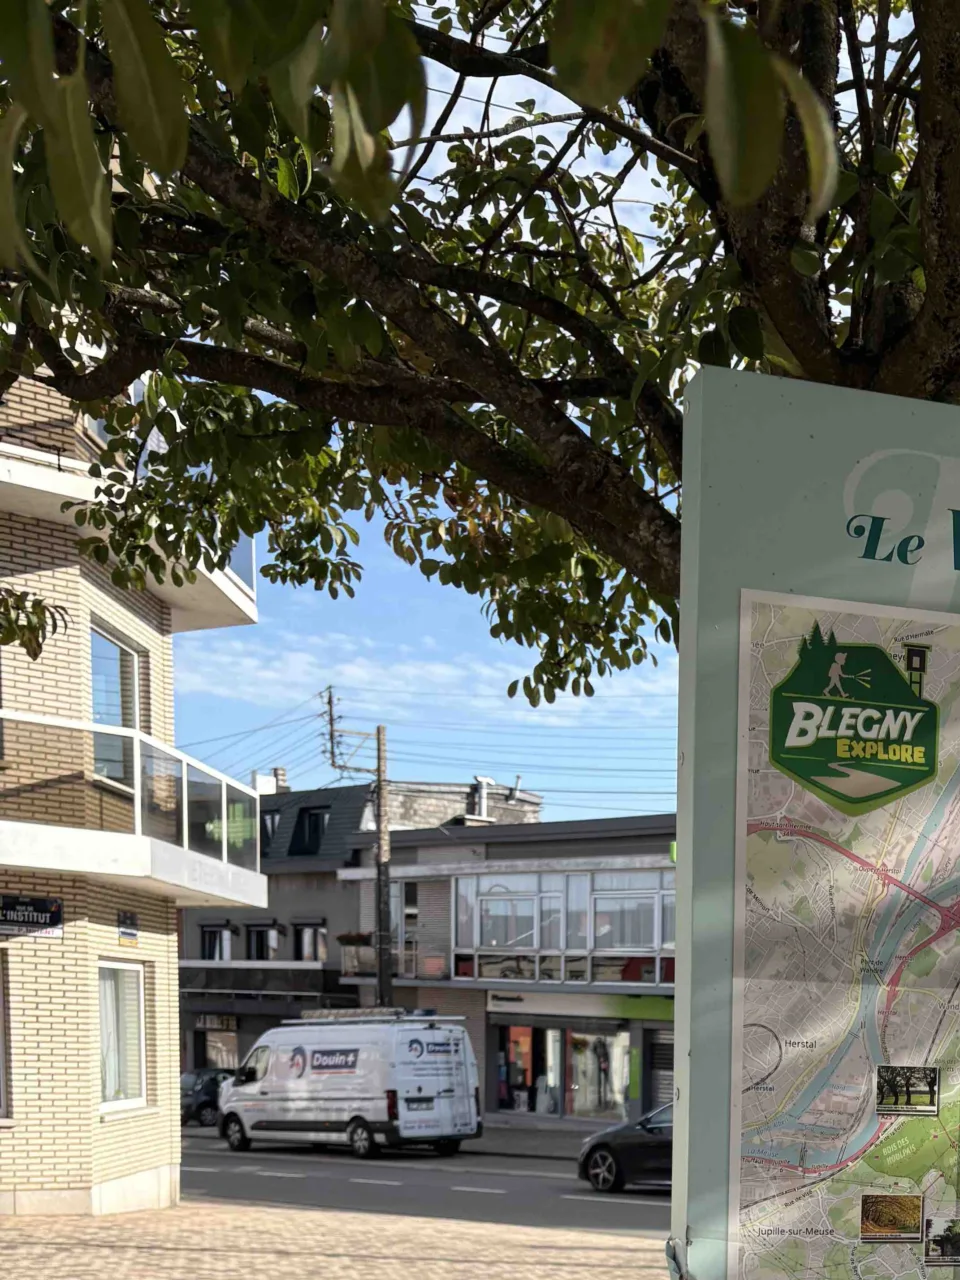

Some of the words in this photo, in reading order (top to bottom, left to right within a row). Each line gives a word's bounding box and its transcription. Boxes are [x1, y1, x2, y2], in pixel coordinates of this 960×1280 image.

[845, 513, 926, 565] Le
[784, 702, 925, 748] BLEGNY
[836, 739, 926, 764] EXPLORE
[784, 1040, 817, 1049] Herstal
[757, 1228, 835, 1238] Jupille-sur-Meuse
